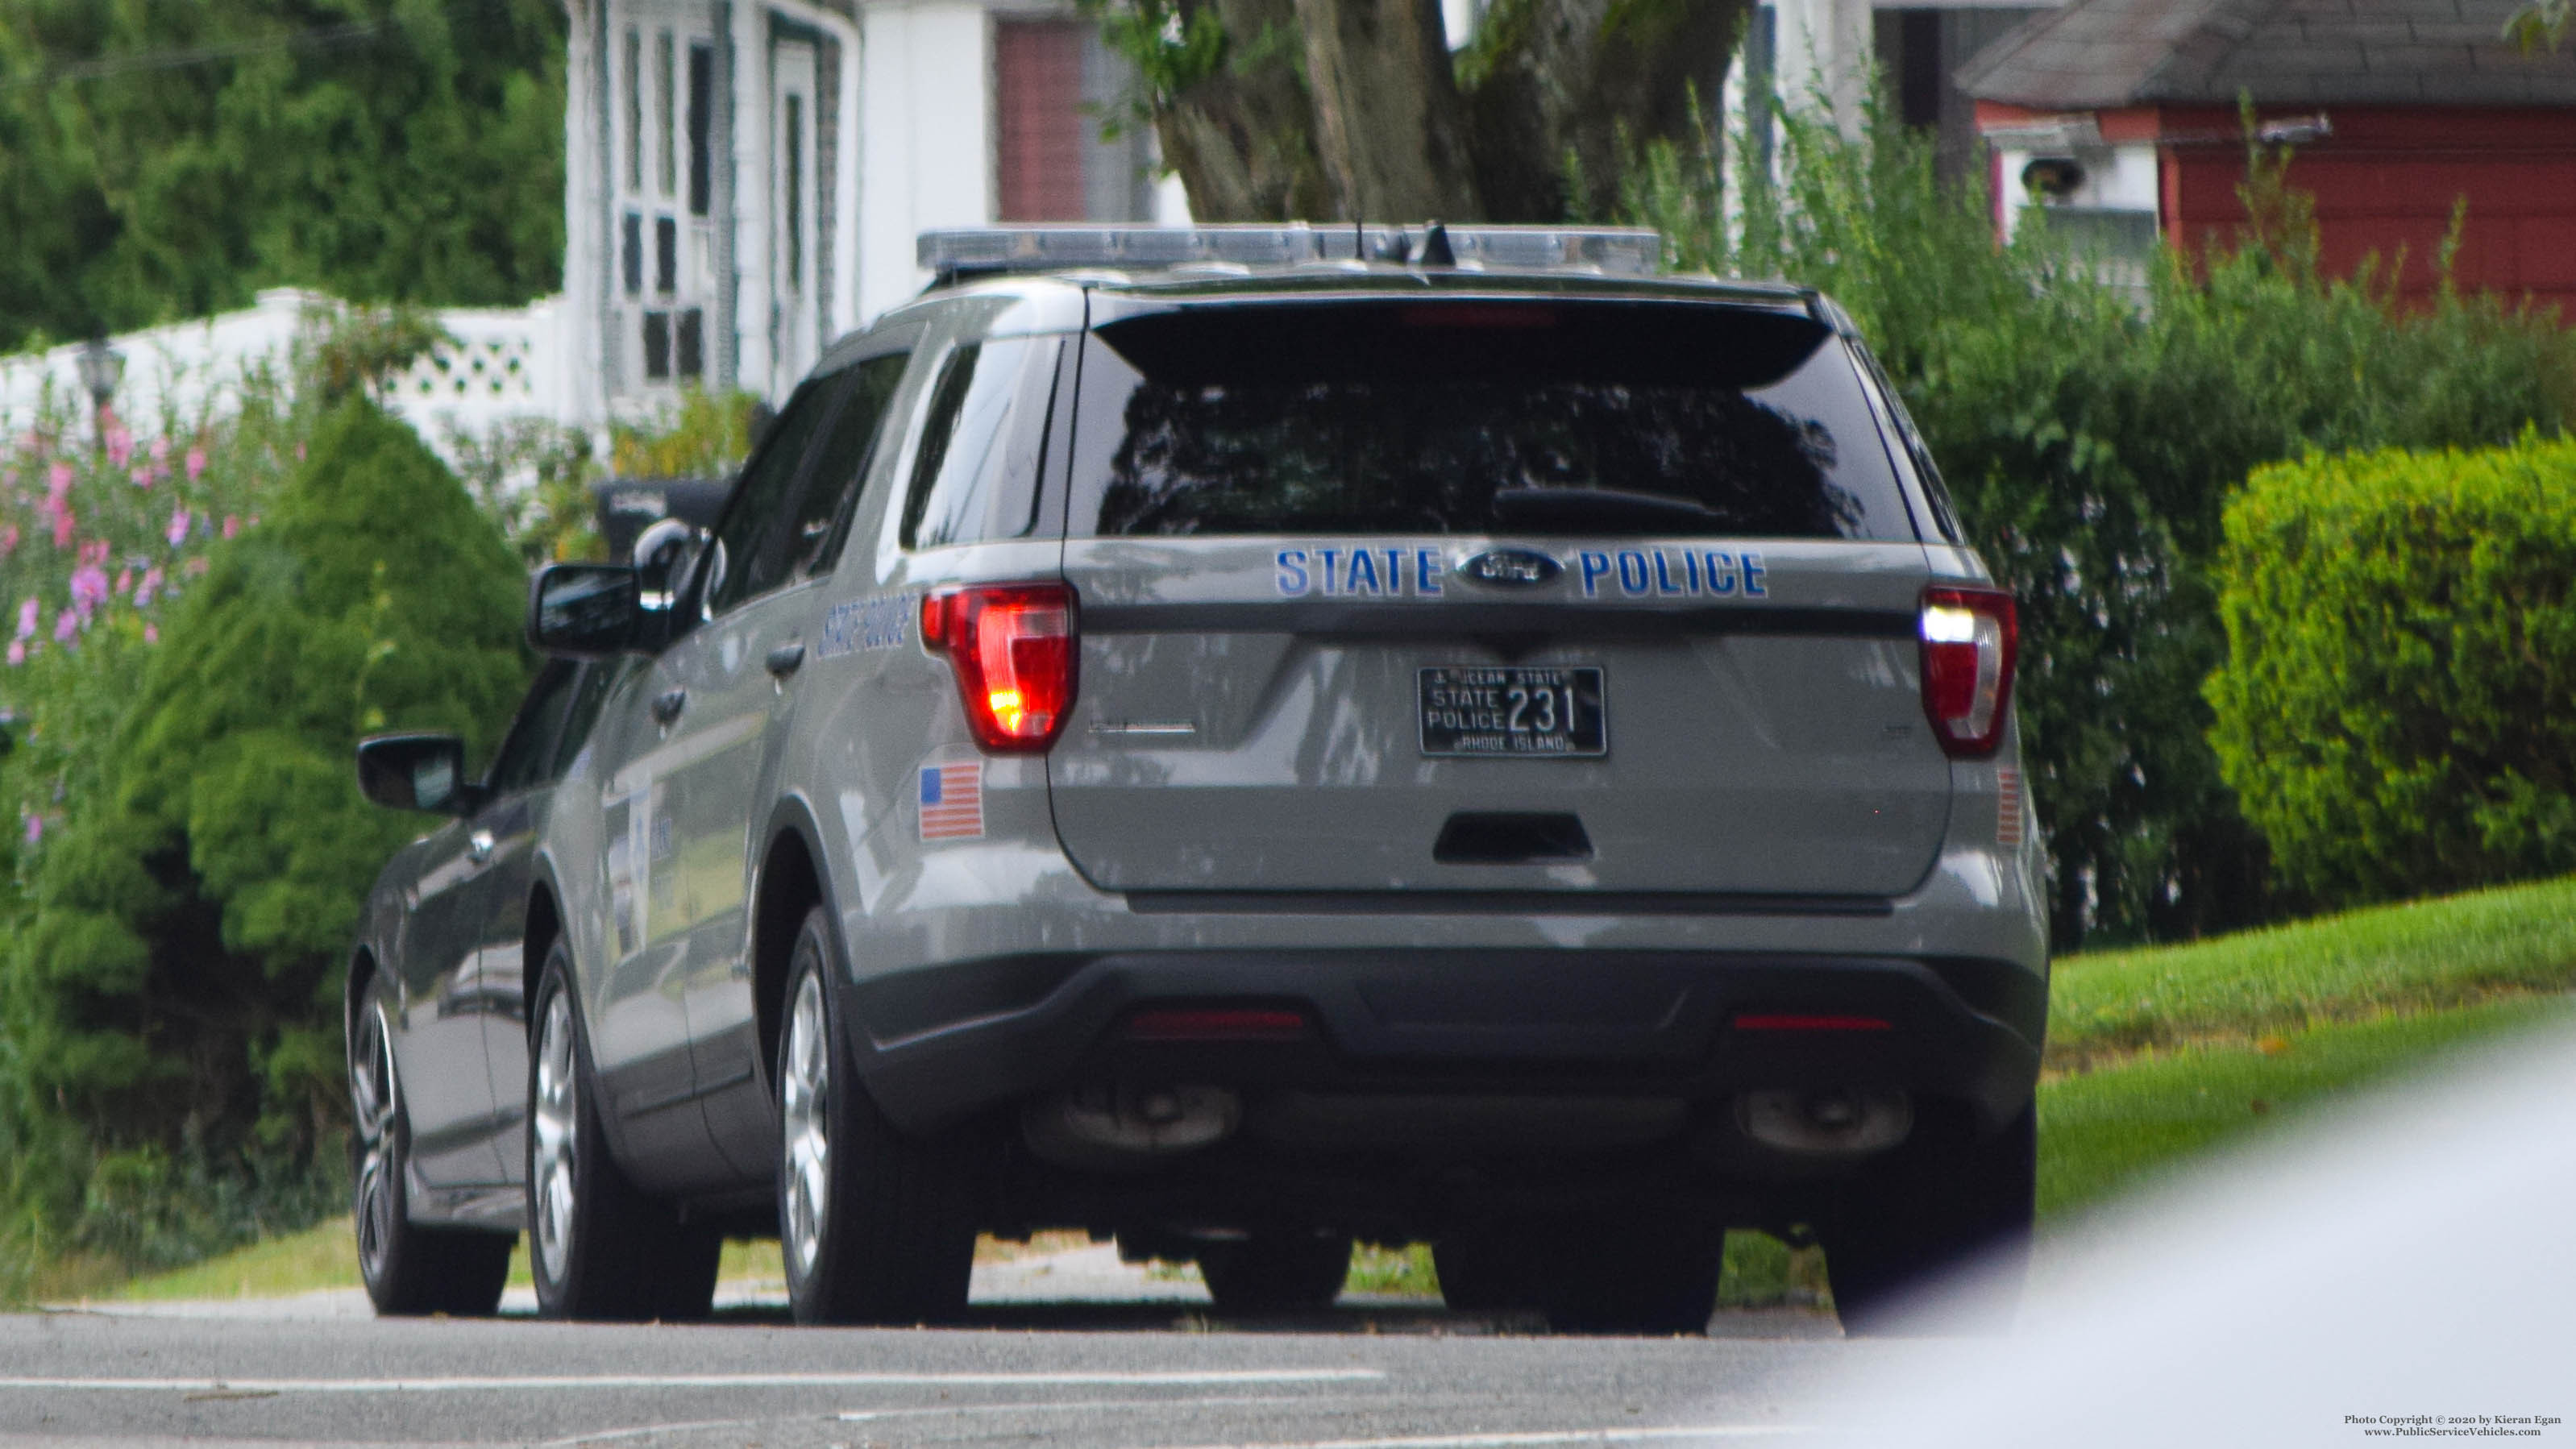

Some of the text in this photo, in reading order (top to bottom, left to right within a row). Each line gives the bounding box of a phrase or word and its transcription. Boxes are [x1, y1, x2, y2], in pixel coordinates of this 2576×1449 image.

[1276, 545, 1768, 600] STATE POLICE
[1517, 670, 1560, 684] STATE
[1432, 689, 1499, 708] STATE
[1427, 709, 1506, 730] POLICE
[1507, 687, 1575, 733] 231
[1462, 734, 1564, 750] RHODE ISLAND
